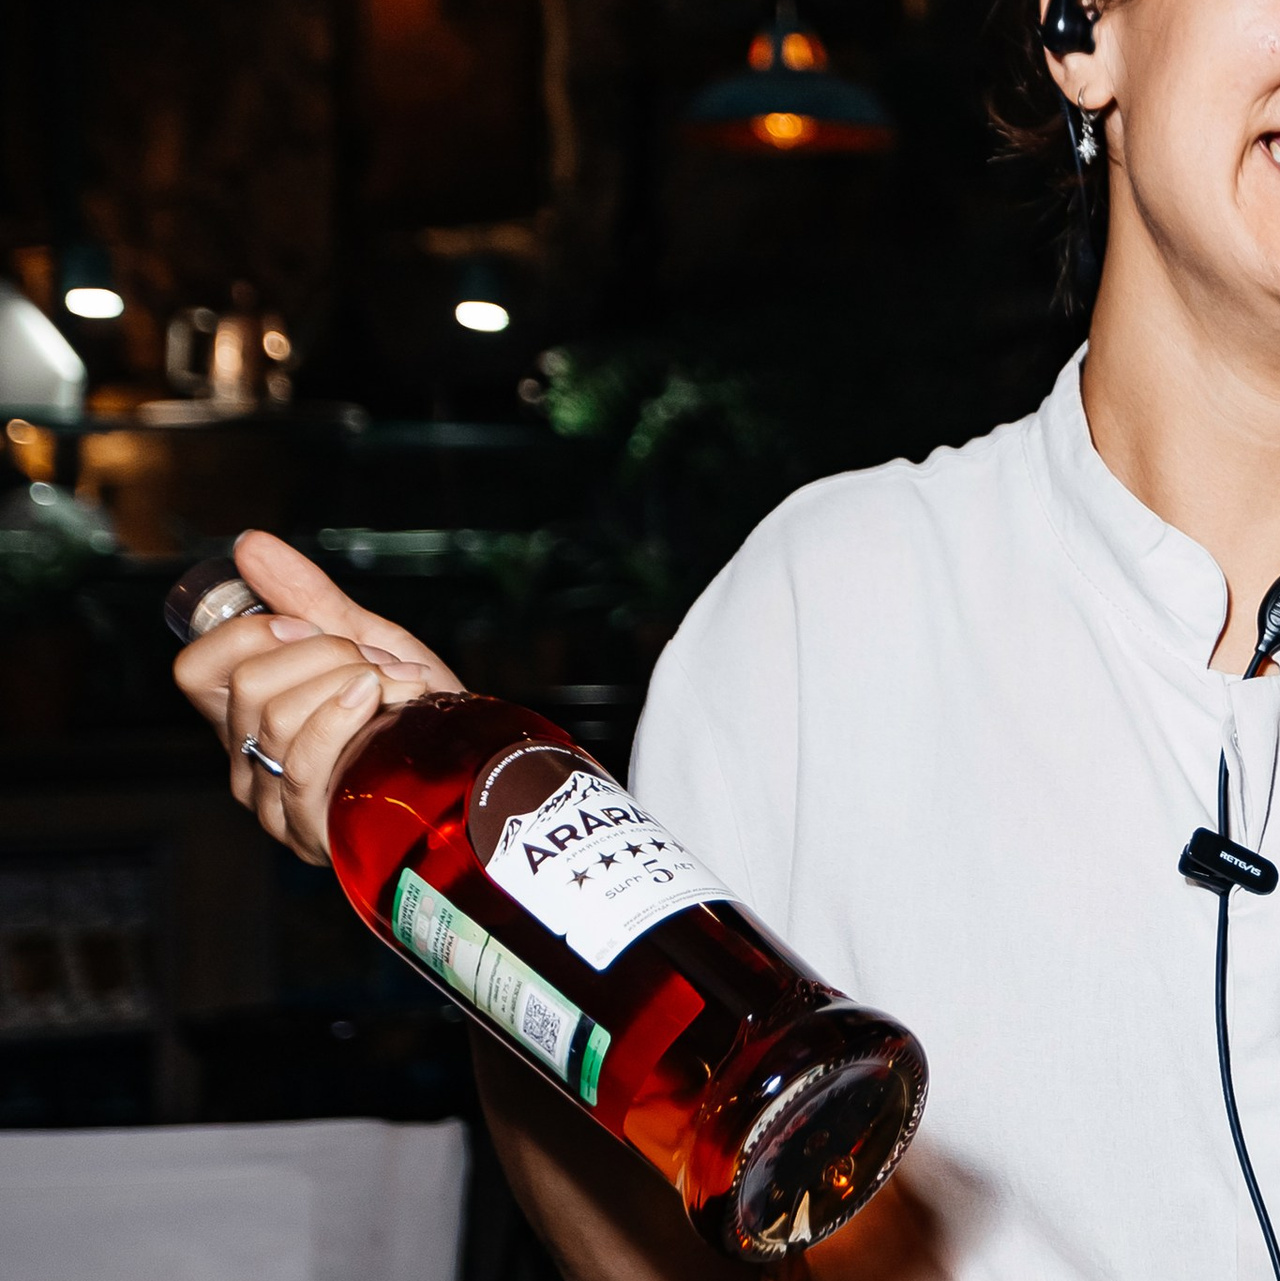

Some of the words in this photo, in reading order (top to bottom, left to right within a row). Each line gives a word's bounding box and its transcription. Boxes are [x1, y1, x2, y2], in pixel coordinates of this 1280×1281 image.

[522, 803, 668, 876] ARARA
[642, 858, 675, 884] 5
[1219, 850, 1262, 877] RETEVIS
